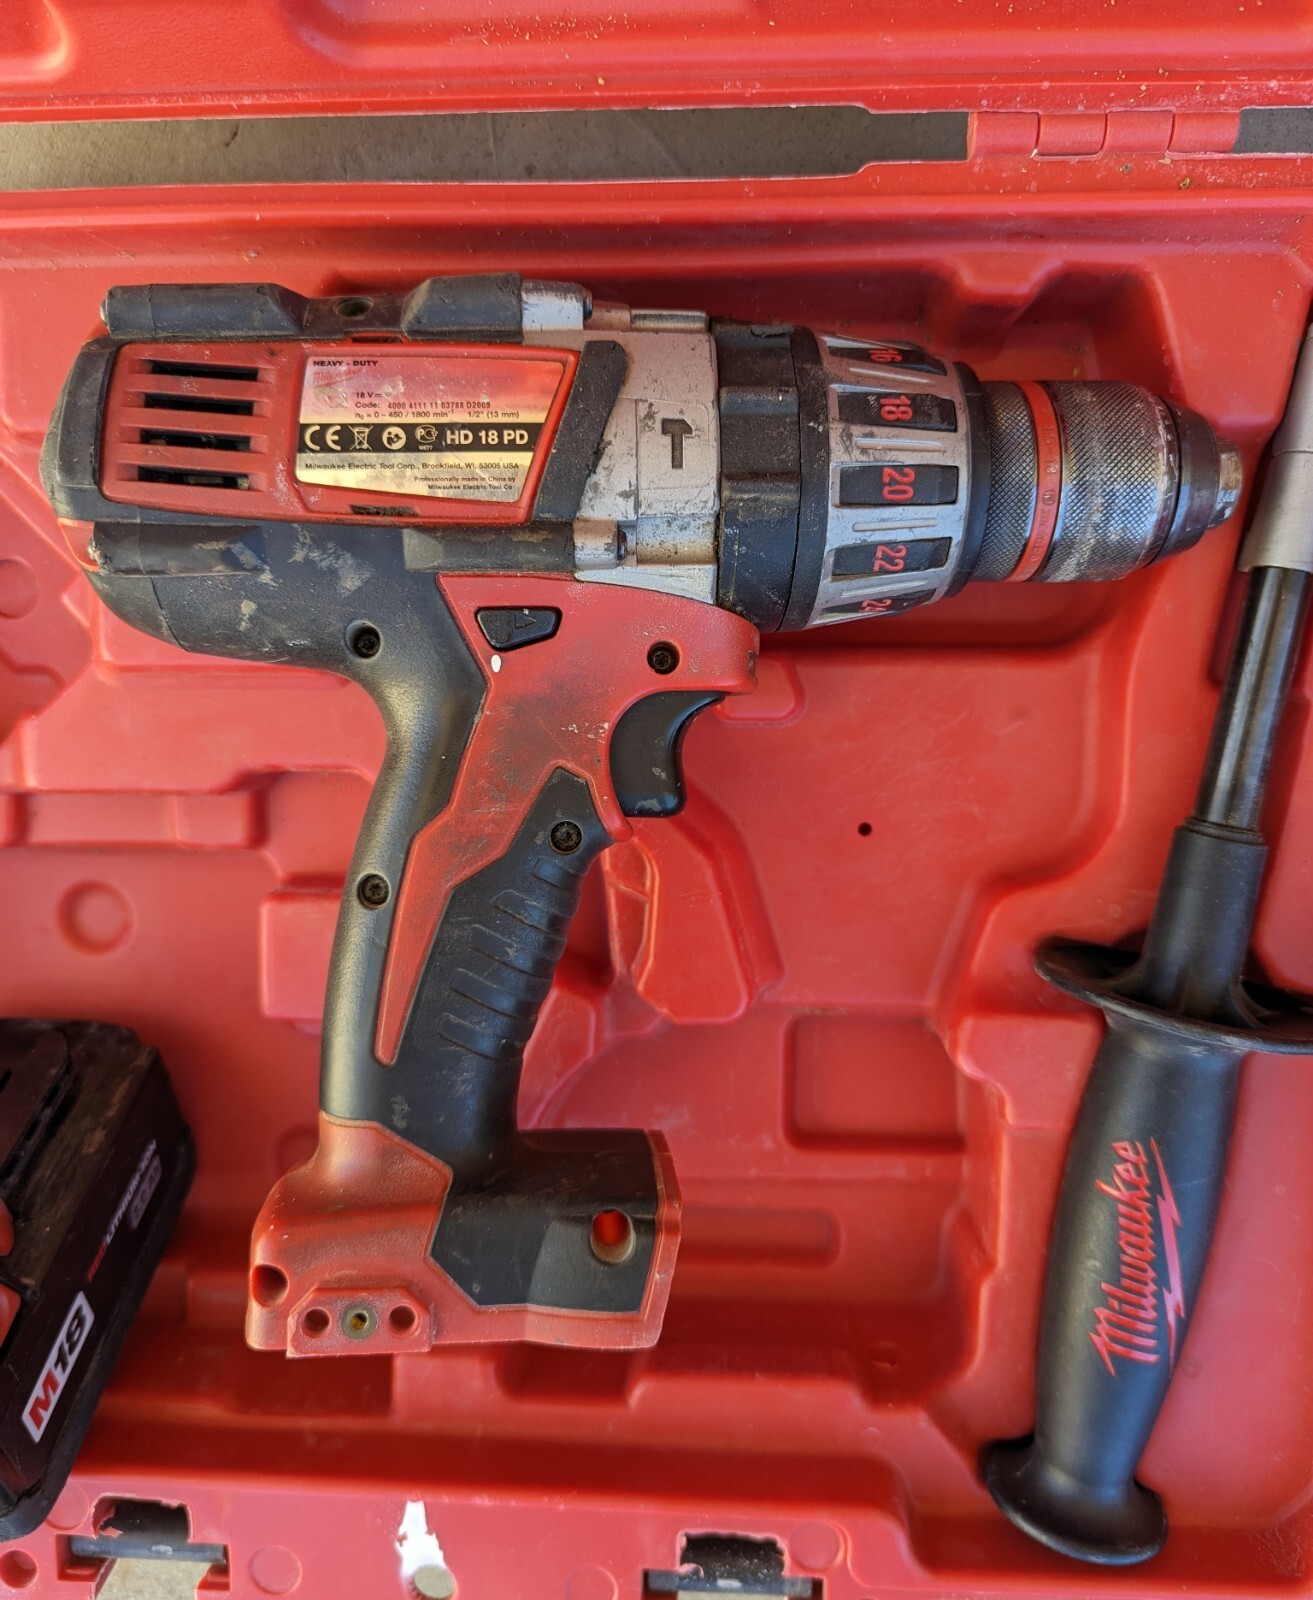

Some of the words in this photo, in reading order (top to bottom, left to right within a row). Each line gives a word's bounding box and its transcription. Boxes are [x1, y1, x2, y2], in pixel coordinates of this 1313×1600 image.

[486, 411, 499, 419] (13
[501, 411, 520, 419] mm)
[879, 395, 913, 421] 18
[446, 430, 473, 445] HD
[479, 430, 499, 445] 18
[503, 430, 529, 445] PD
[882, 467, 915, 501] 20
[873, 545, 907, 572] 22
[1088, 1141, 1160, 1376] Milwaukee
[28, 1304, 87, 1430] M18
